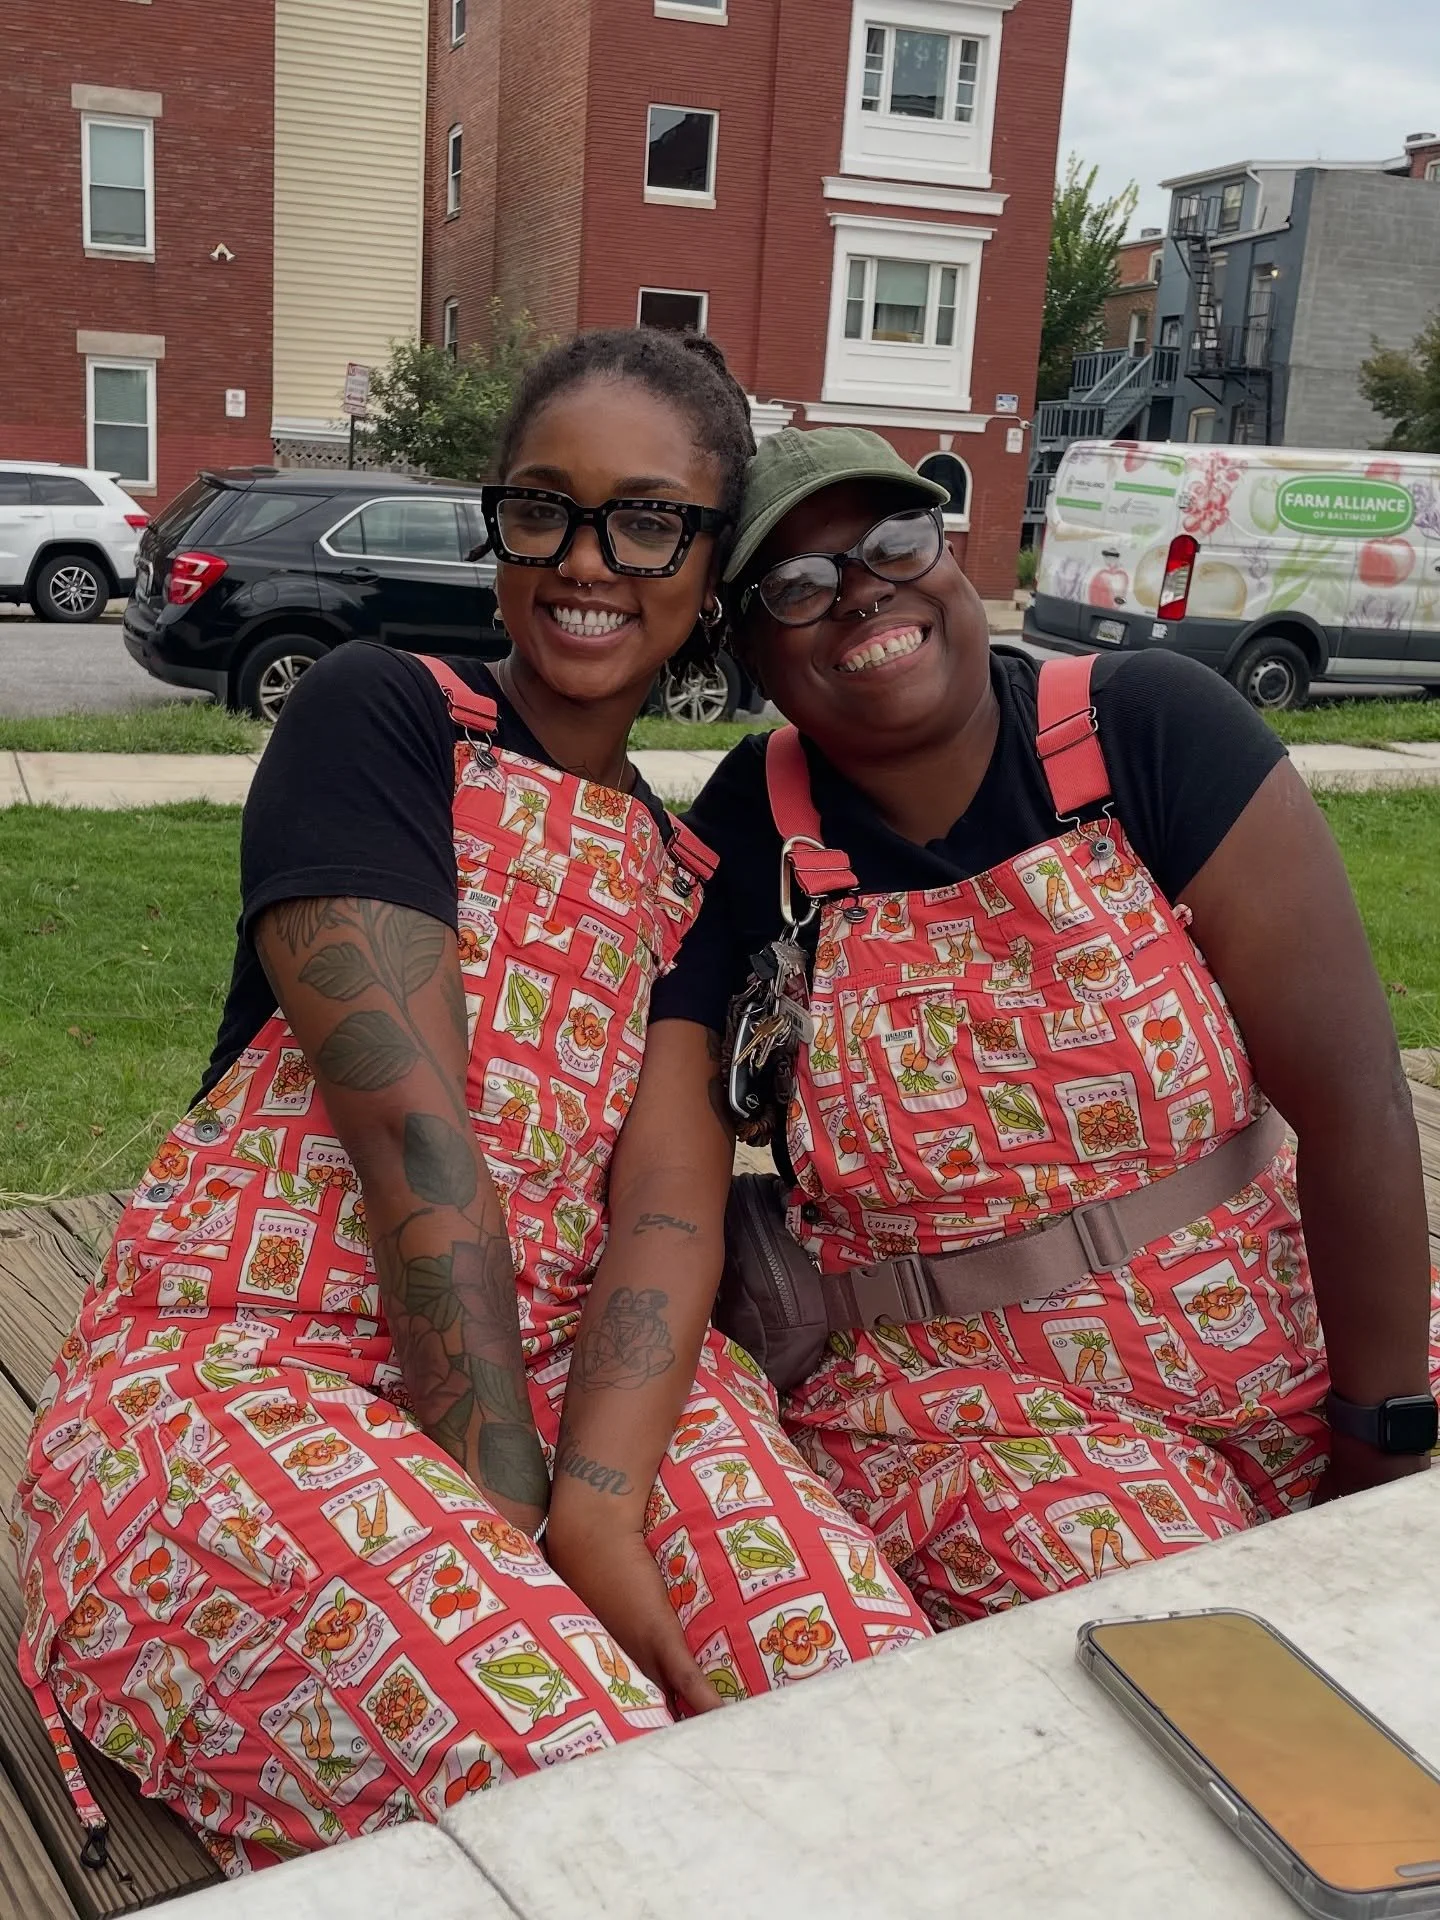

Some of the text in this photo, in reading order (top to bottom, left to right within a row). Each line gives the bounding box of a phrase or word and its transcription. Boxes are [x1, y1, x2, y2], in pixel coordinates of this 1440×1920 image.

[1285, 493, 1406, 513] FARM ALLIANCE
[1313, 511, 1377, 522] OF BALTIMORE
[459, 910, 490, 926] ANSY
[931, 921, 970, 934] CARROT
[1055, 911, 1090, 930] CARROT
[583, 921, 620, 943] CARROT
[514, 963, 549, 984] PEAS
[1088, 980, 1127, 1000] PANSY
[1055, 1030, 1107, 1047] CARROT
[563, 1050, 597, 1069] PANSY
[980, 1052, 1025, 1061] COSMOS
[276, 1096, 306, 1104] COSM
[1067, 1087, 1128, 1106] COSMOS
[1008, 1132, 1044, 1145] PEAS
[307, 1152, 352, 1164] COSM
[259, 1223, 308, 1237] COSMOS
[868, 1220, 910, 1231] COSMOS
[325, 1286, 358, 1305] TOMA
[162, 1307, 205, 1317] CARROT
[1216, 1314, 1253, 1340] PANSY
[1085, 1382, 1127, 1391] ARROT
[938, 1389, 963, 1426] TOMATO
[193, 1424, 205, 1453] TOM
[1104, 1450, 1148, 1465] PANSY
[314, 1458, 360, 1485] PANSY
[328, 1481, 380, 1512] CARROT
[122, 1503, 155, 1546] CARROT
[172, 1559, 188, 1596] TOMA
[413, 1552, 434, 1603] TOMATO
[752, 1569, 796, 1592] PEAS
[231, 1612, 252, 1639] COSM
[342, 1629, 381, 1676] PANSY
[472, 1631, 520, 1665] PEAS
[133, 1641, 157, 1681] CARRO
[211, 1722, 230, 1747] NSY
[401, 1709, 443, 1758] COSMOS
[544, 1730, 602, 1765] COSMOS
